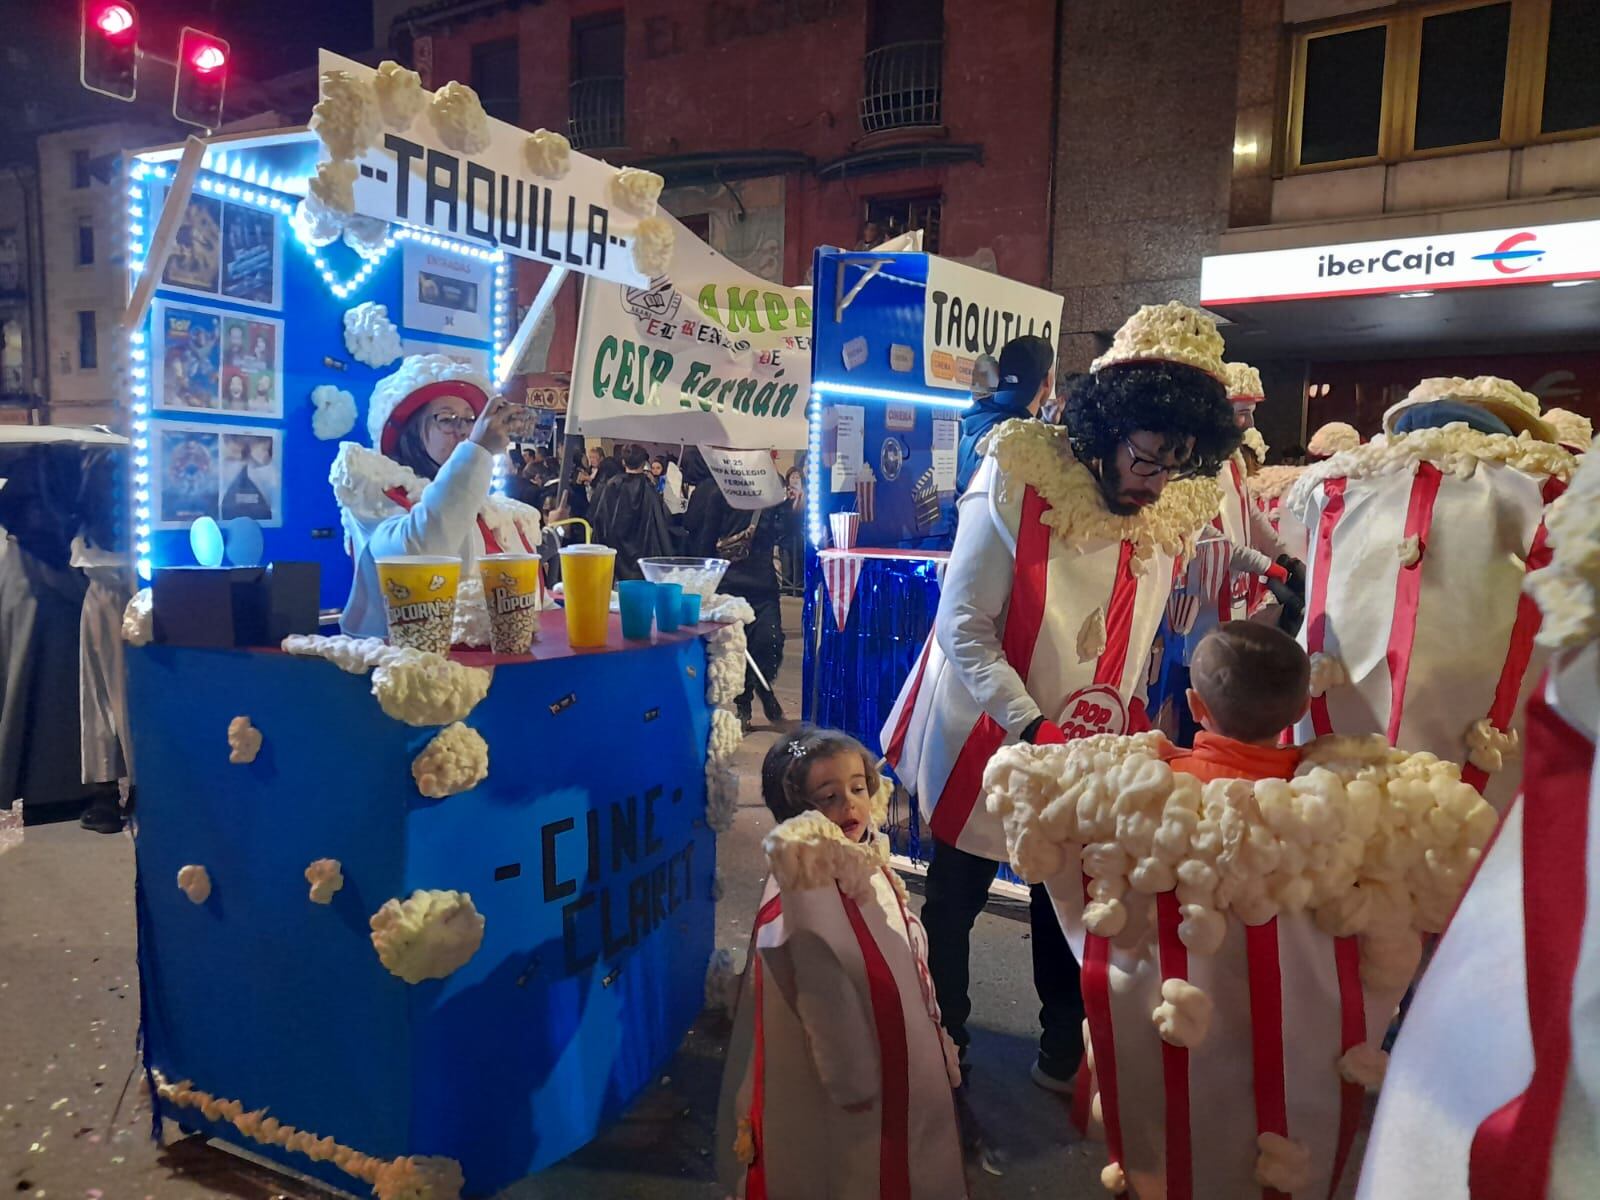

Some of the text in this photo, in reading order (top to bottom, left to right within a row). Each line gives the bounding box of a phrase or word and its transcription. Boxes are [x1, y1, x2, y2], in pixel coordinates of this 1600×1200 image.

[1317, 245, 1455, 278] iberCaja
[698, 283, 812, 333] AMPA
[646, 318, 677, 340] EL
[759, 349, 781, 366] DE
[592, 334, 799, 418] CEIP Fernán
[730, 468, 767, 477] COLEGIO
[1071, 699, 1112, 727] POP
